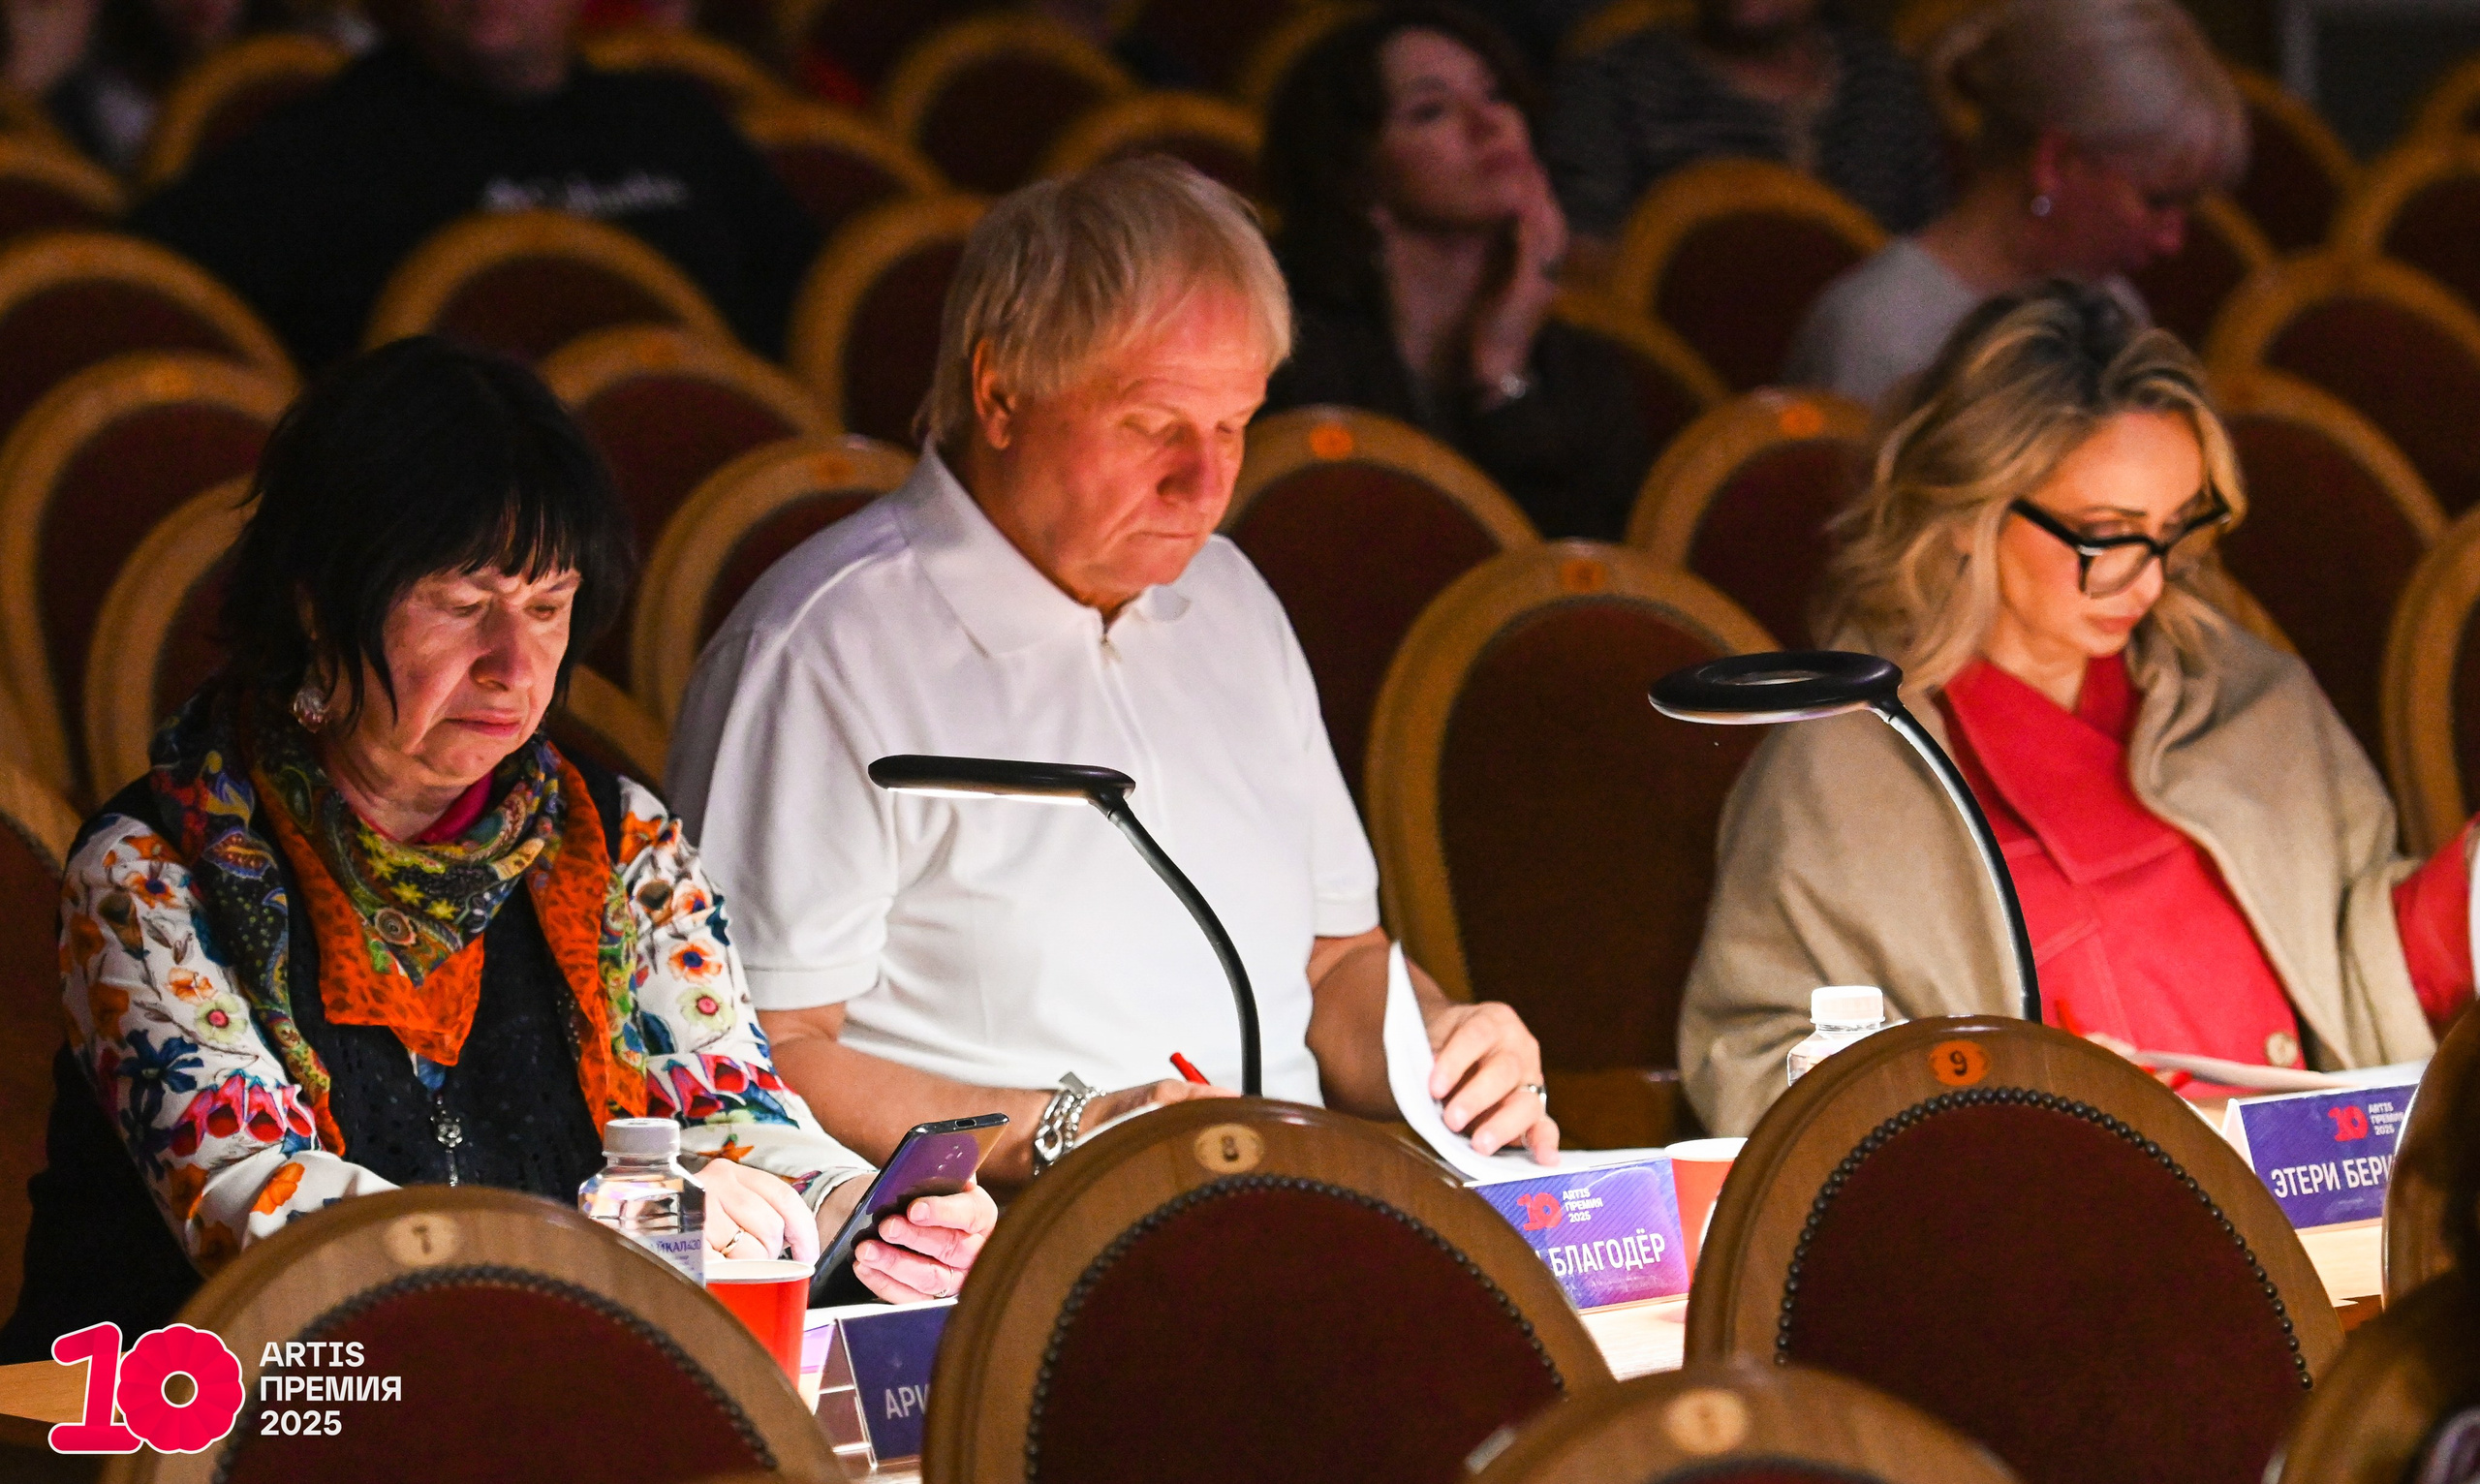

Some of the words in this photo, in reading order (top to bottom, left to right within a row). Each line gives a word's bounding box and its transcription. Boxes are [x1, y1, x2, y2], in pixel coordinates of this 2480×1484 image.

[1949, 1050, 1968, 1076] 9
[2373, 1124, 2395, 1135] 2025
[1221, 1135, 1241, 1162] 8
[2271, 1161, 2340, 1197] ЭТЕРИ
[1563, 1189, 1591, 1200] ARTIS
[1565, 1197, 1603, 1211] ПРЕМИЯ
[1516, 1191, 1563, 1231] 10
[1568, 1212, 1592, 1222] 2025
[1548, 1228, 1665, 1277] БЛАГОДЁР
